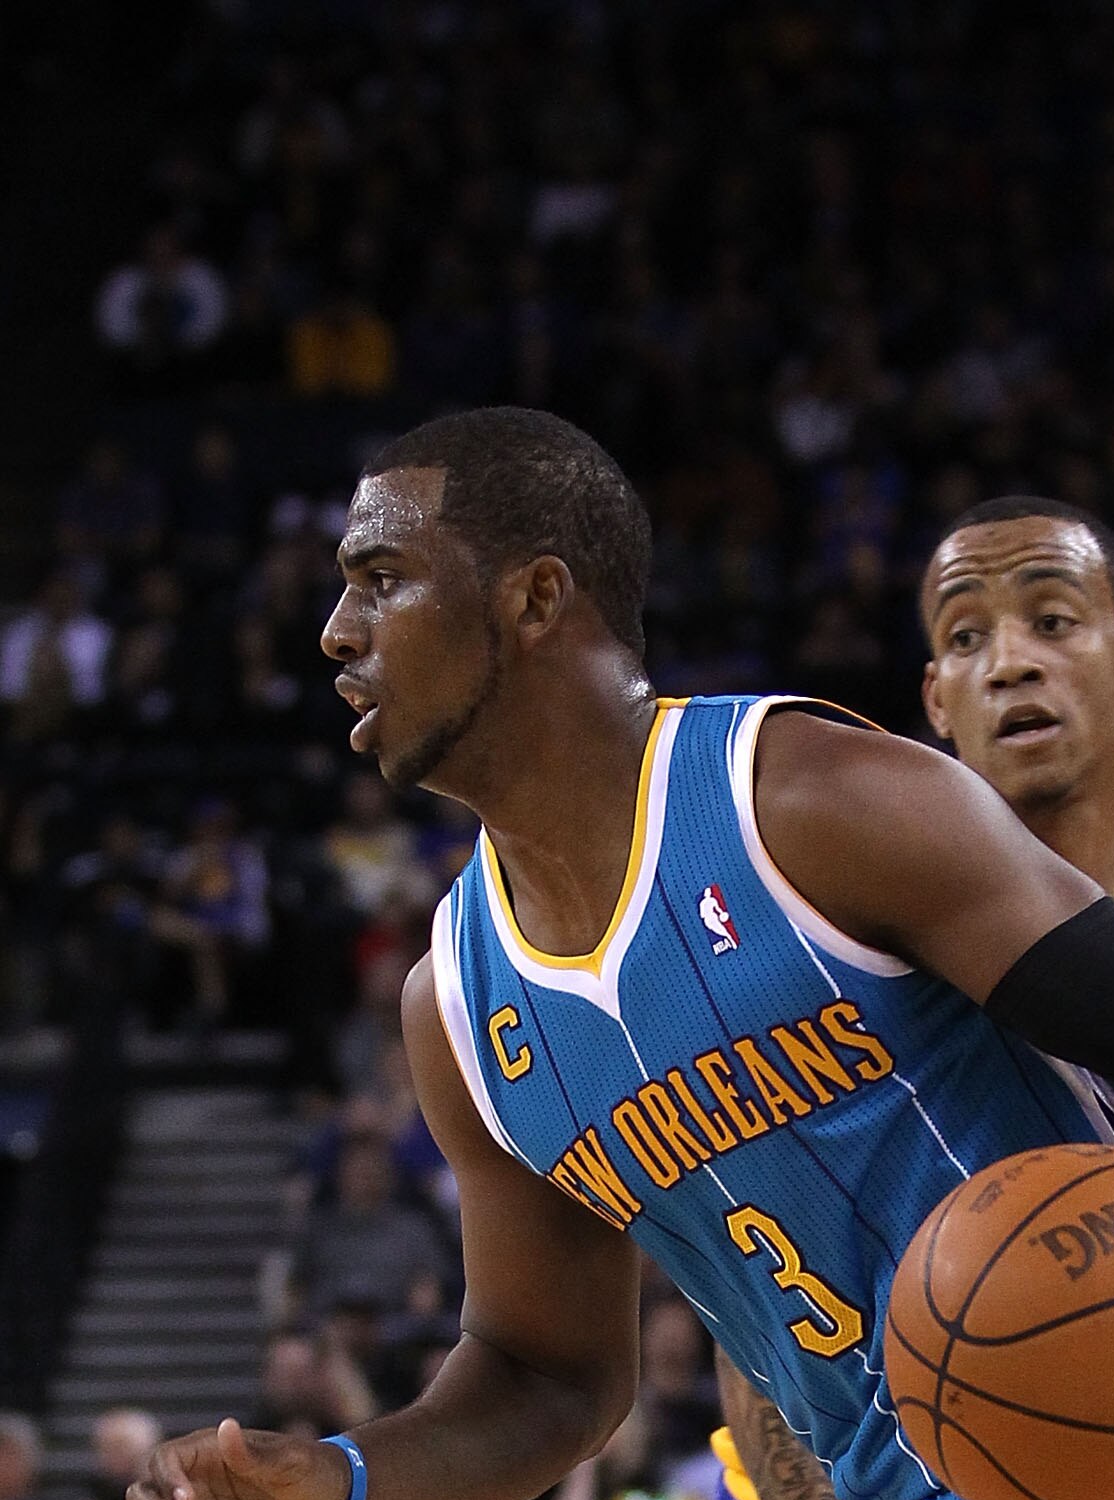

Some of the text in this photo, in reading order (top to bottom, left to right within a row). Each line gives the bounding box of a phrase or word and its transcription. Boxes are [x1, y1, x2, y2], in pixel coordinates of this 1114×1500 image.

[488, 1005, 533, 1082] C
[546, 1001, 896, 1233] EW ORLEANS
[726, 1205, 866, 1359] 3
